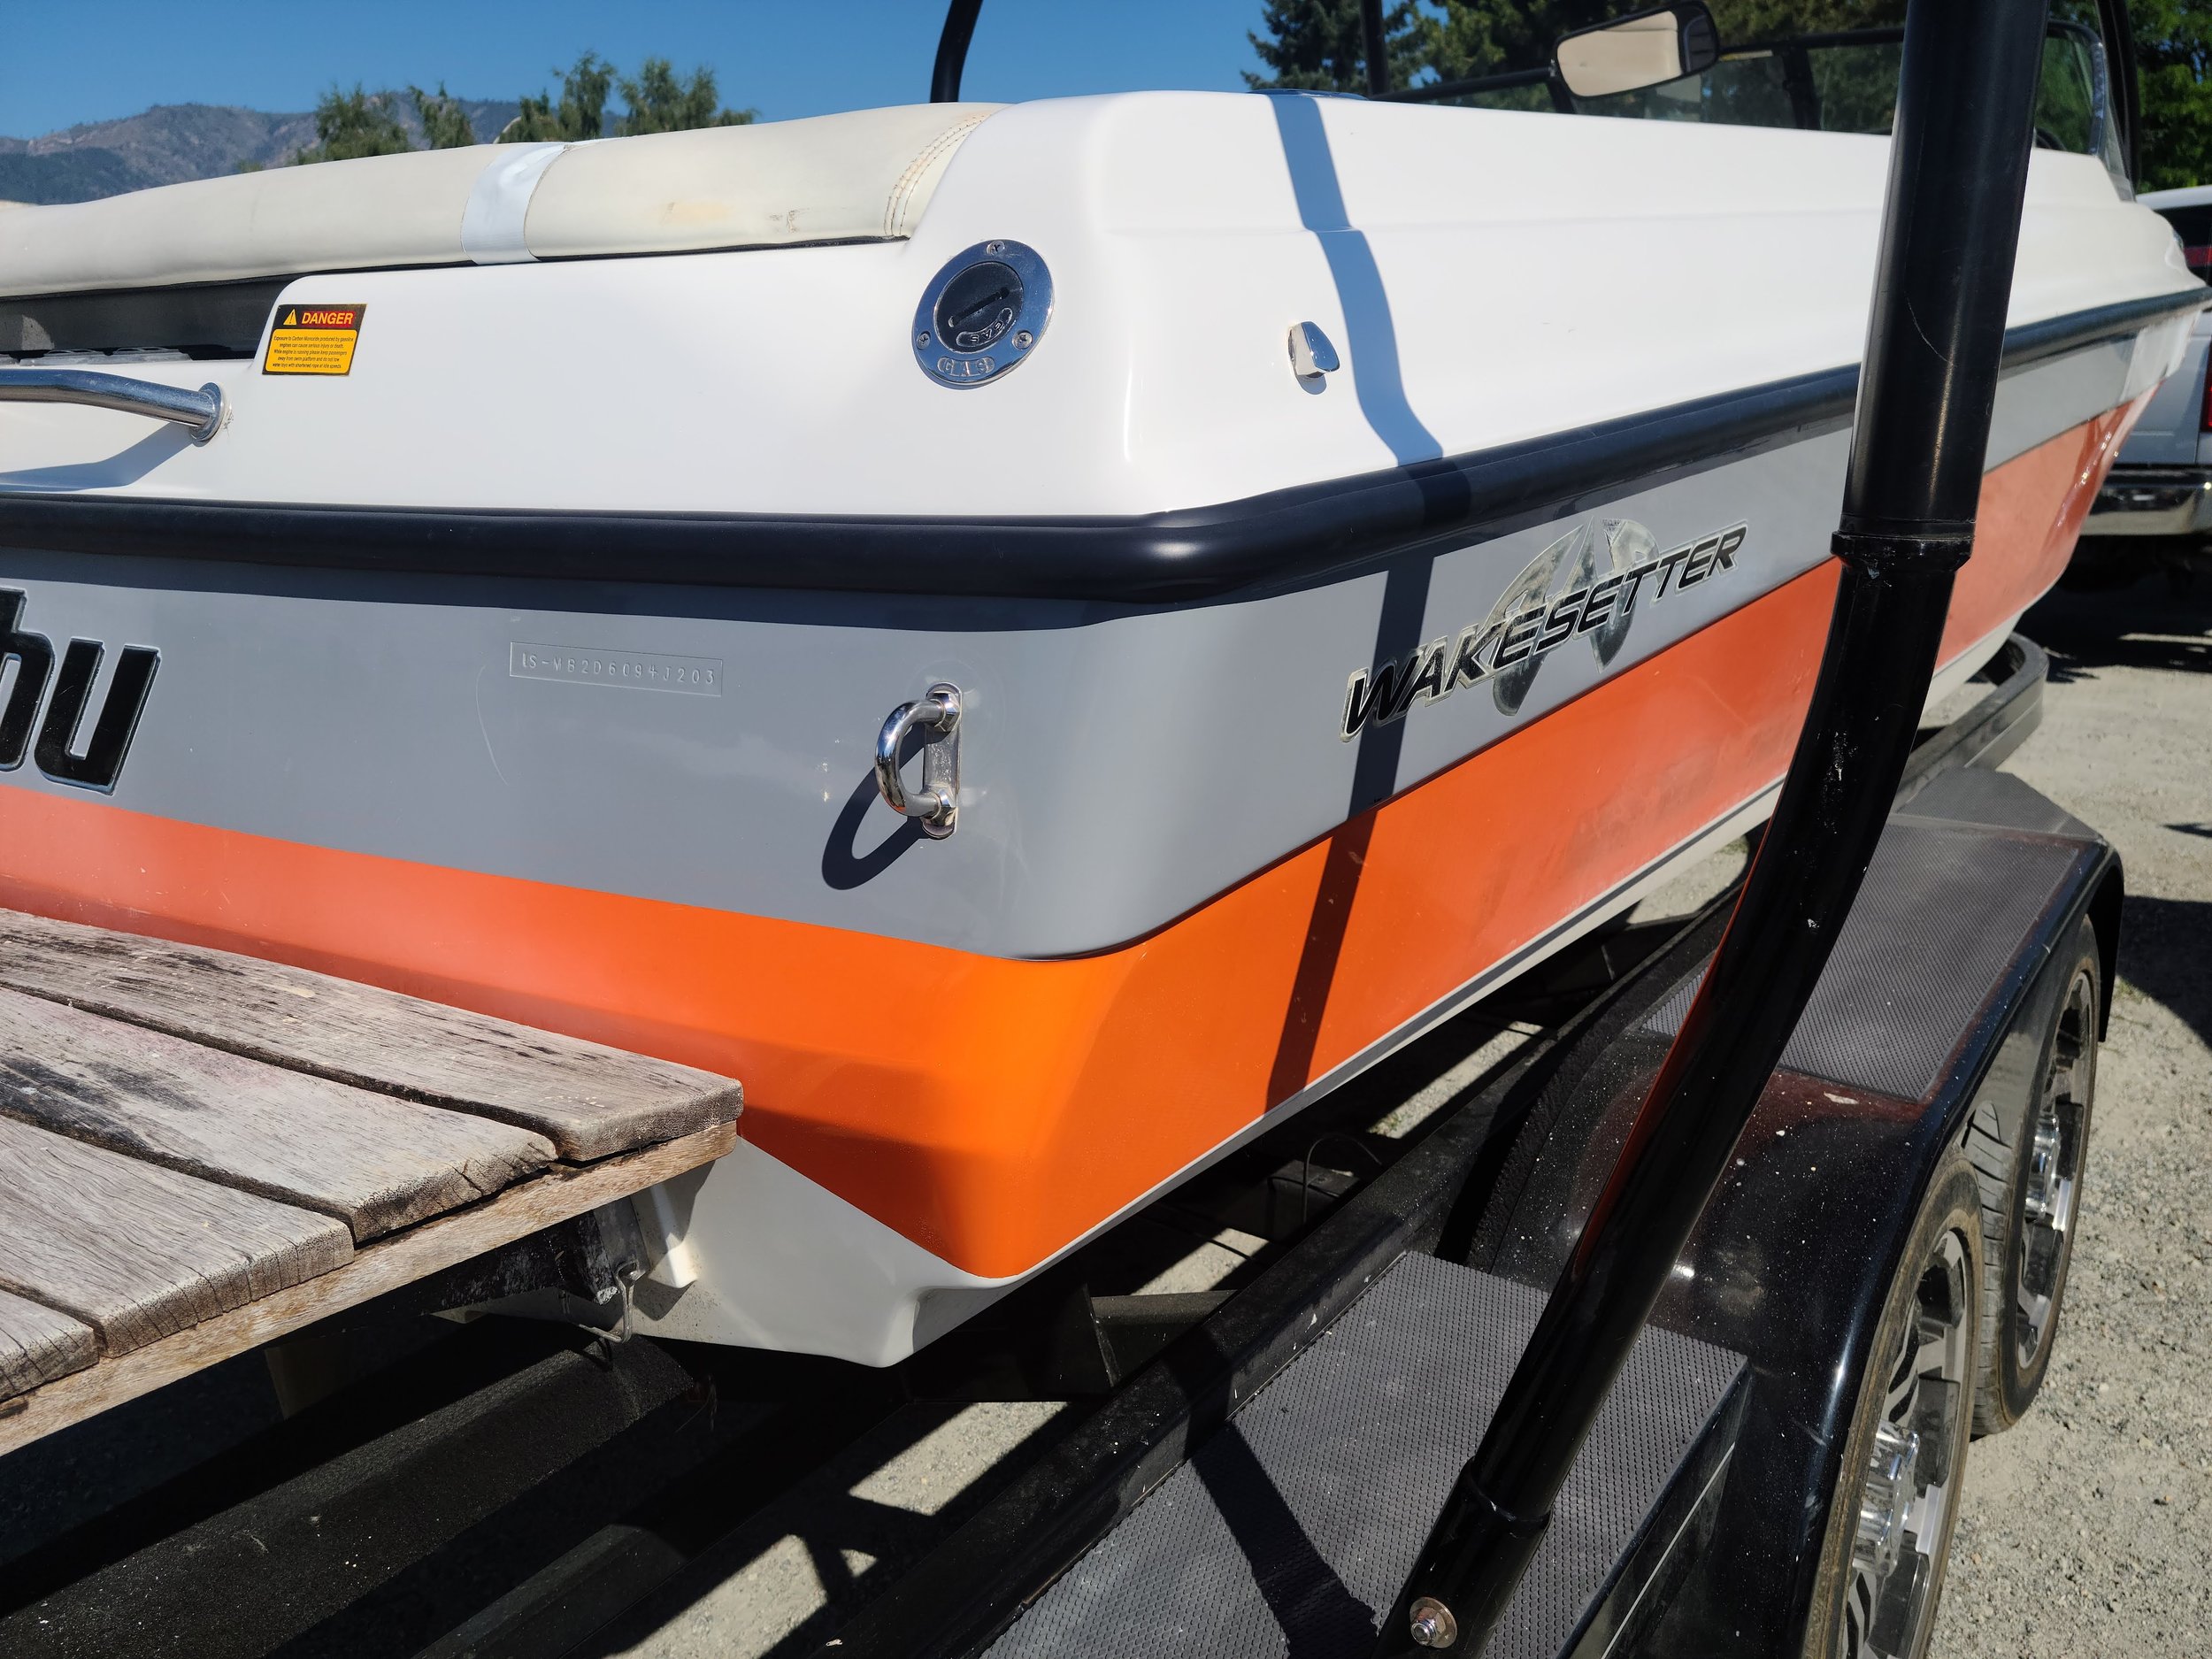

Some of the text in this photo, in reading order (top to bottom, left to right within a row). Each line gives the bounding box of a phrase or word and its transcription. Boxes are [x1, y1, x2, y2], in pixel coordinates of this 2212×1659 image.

[302, 312, 354, 325] DANGER
[971, 320, 1004, 342] GAS
[945, 357, 987, 377] GAS
[1340, 520, 1748, 741] WAKESETTER
